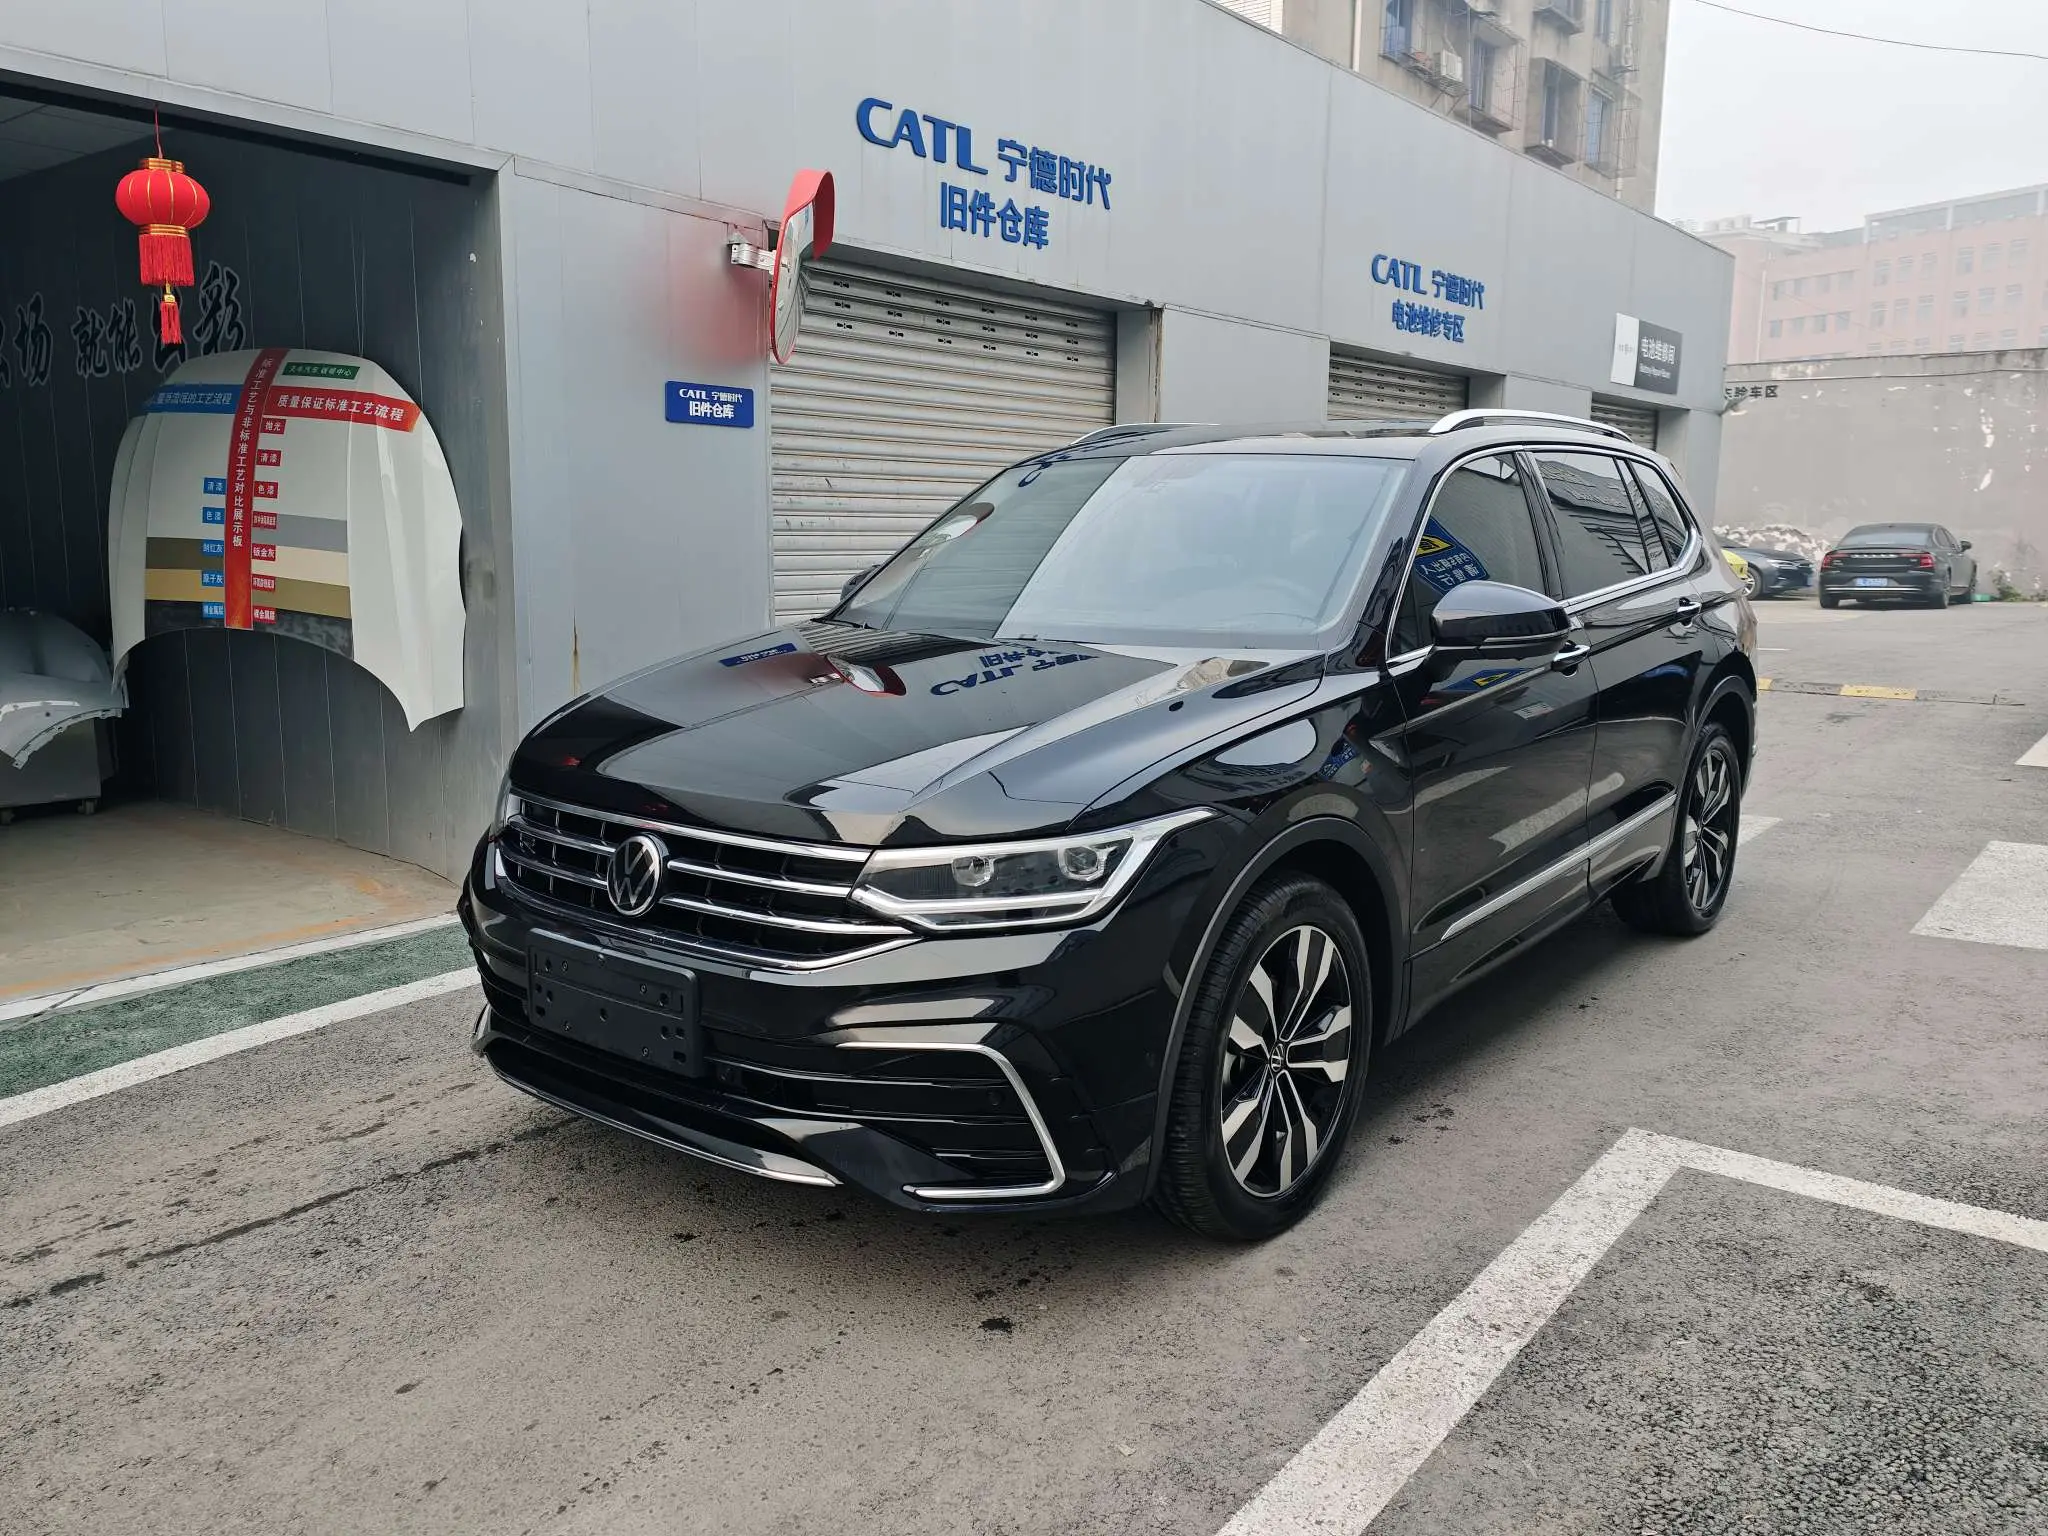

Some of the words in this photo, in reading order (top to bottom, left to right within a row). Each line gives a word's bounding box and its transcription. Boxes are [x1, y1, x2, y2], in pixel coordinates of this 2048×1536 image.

[856, 97, 989, 175] CATL
[997, 137, 1112, 210] 宁德时代
[940, 181, 1050, 250] 旧件仓库
[1371, 253, 1428, 295] CATL
[1431, 269, 1485, 310] 宁德时代
[1392, 298, 1466, 343] 电池维修专区
[277, 394, 405, 422] 质量保证标准工艺流程
[679, 388, 710, 400] CATL
[711, 391, 743, 403] 宁德时代
[689, 400, 735, 419] 旧件仓库
[265, 420, 282, 431] 抛光
[232, 357, 274, 547] 标准工艺与非标准工艺对比展示板
[260, 453, 278, 463] 清漆
[257, 484, 275, 495] 色漆
